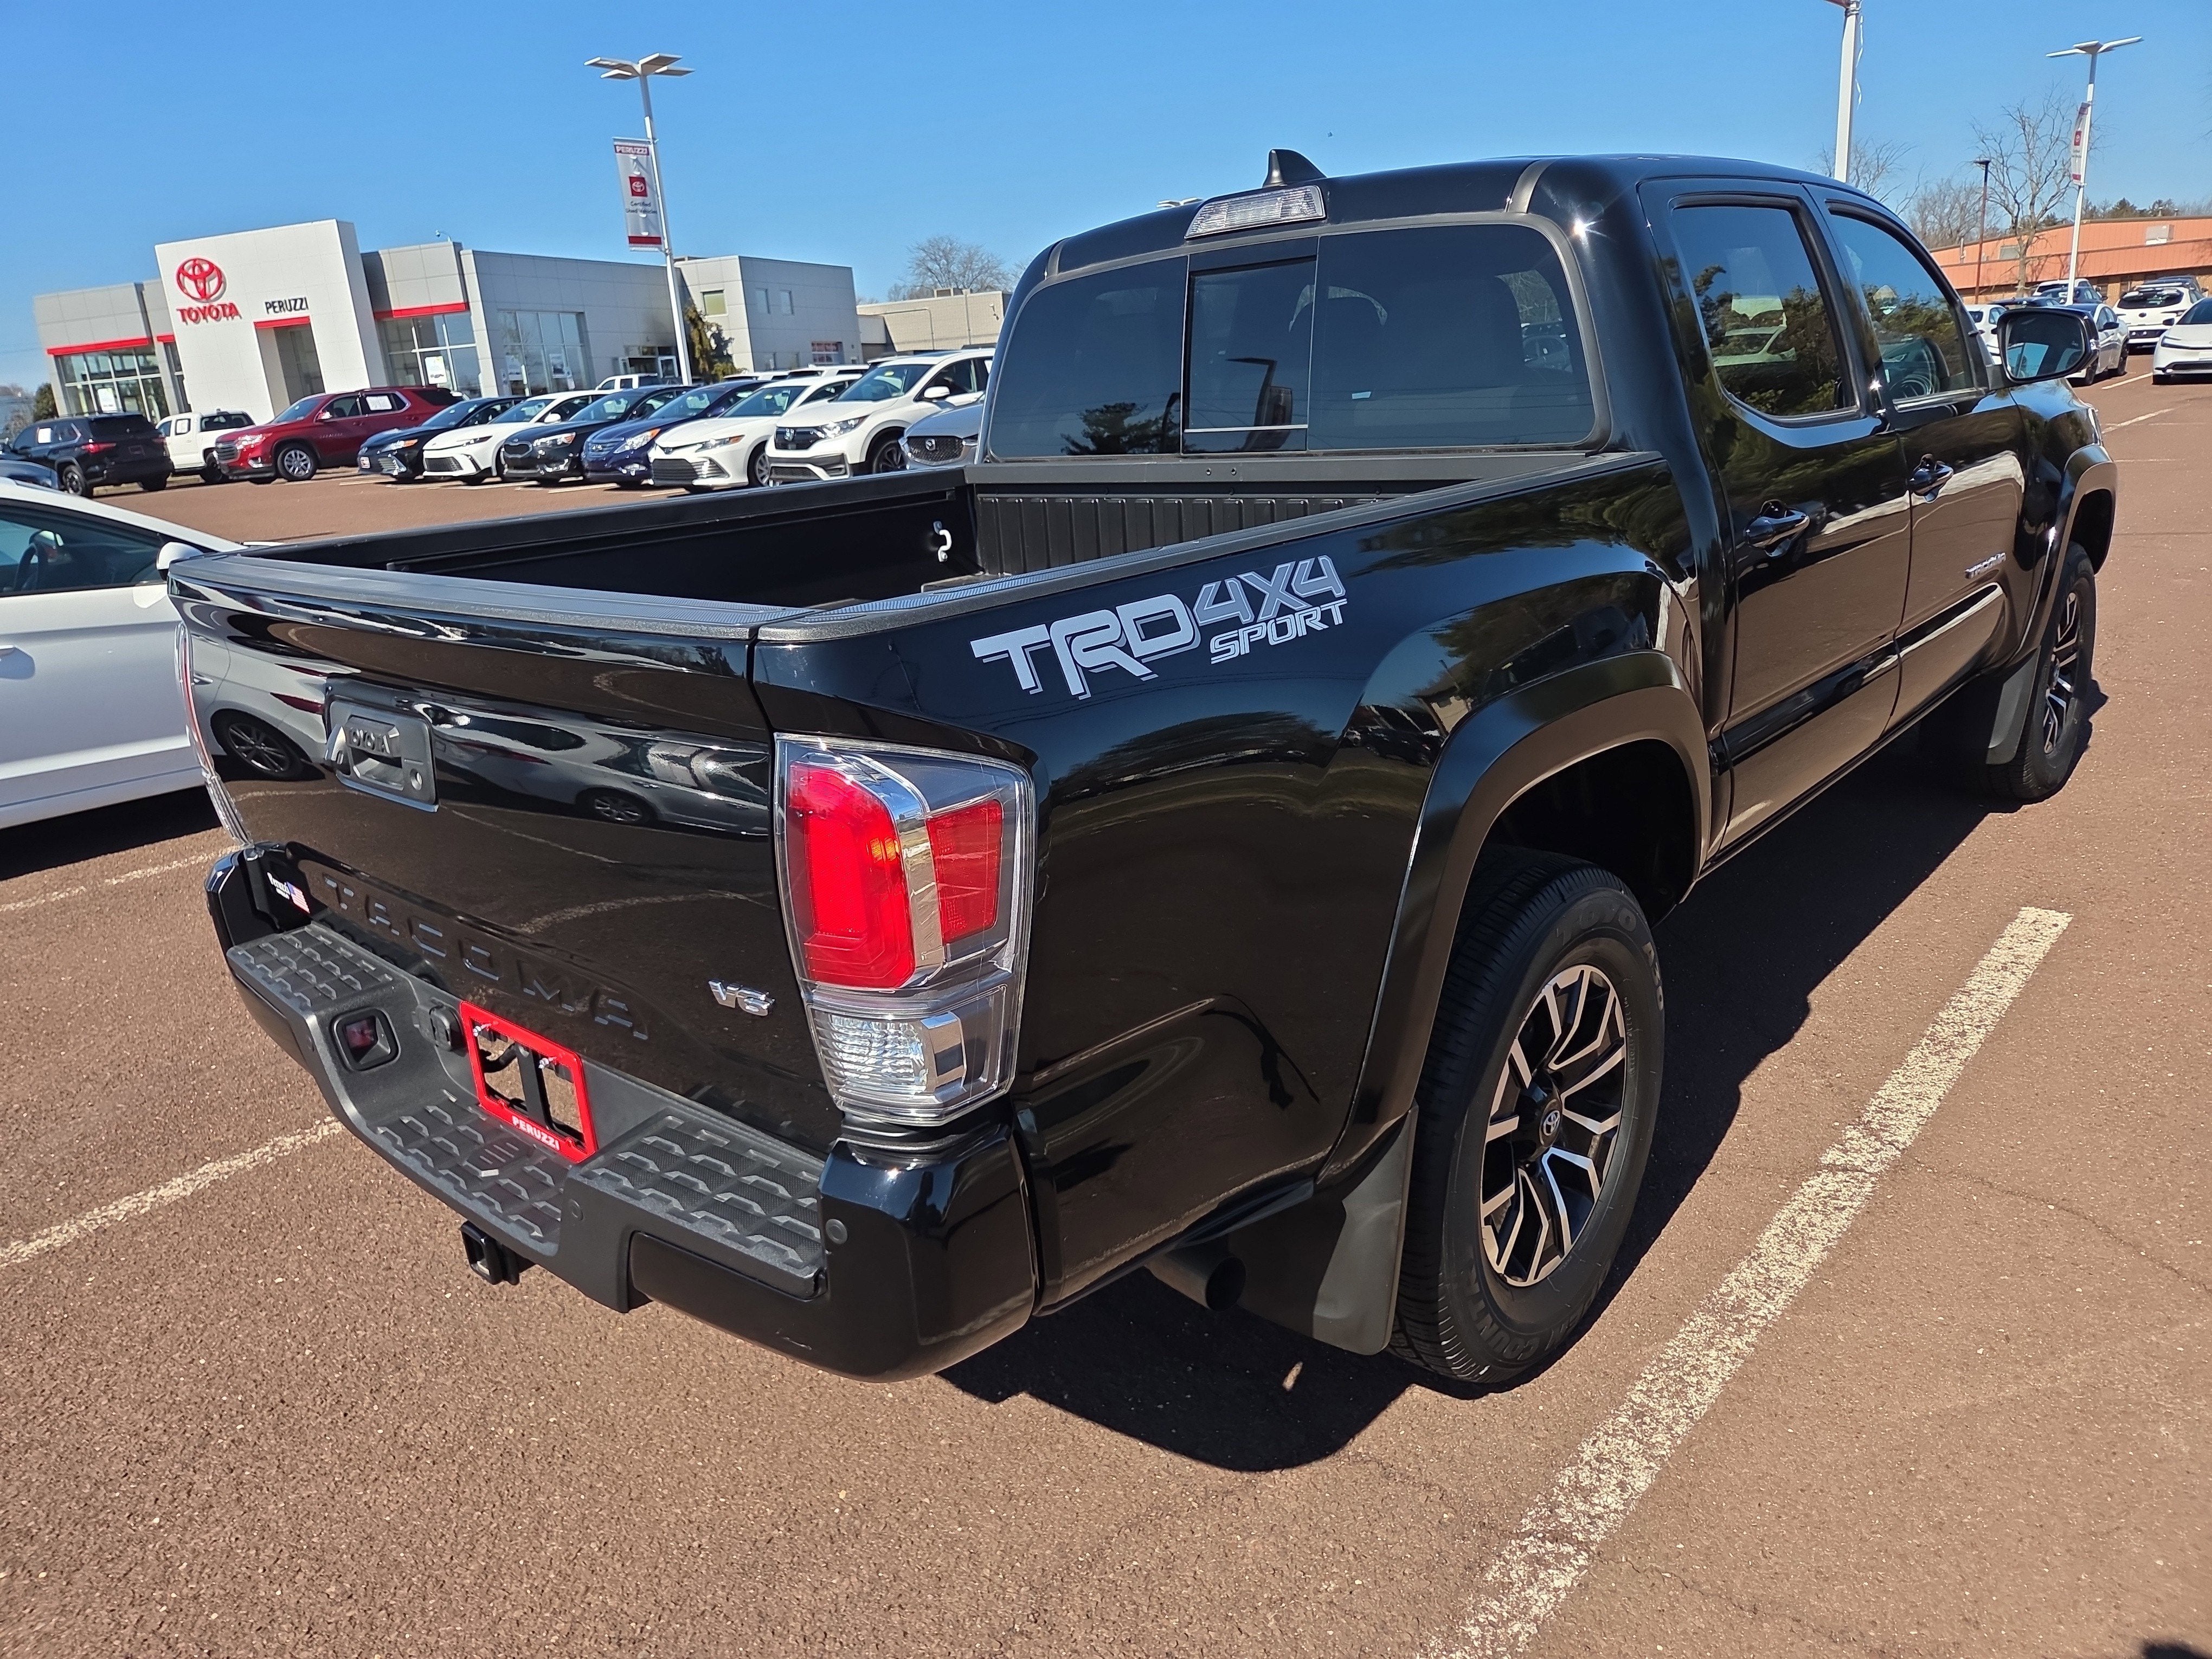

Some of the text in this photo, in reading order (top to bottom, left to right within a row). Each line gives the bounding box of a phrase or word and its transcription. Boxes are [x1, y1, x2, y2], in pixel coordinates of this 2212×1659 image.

[176, 302, 242, 325] TOYOTA
[265, 297, 308, 314] PERUZZI
[969, 593, 1201, 700] TRD
[1210, 598, 1348, 665] SPORT
[323, 873, 648, 1040] TACOMA
[708, 979, 776, 1017] V6
[511, 1115, 561, 1151] PERUZZI
